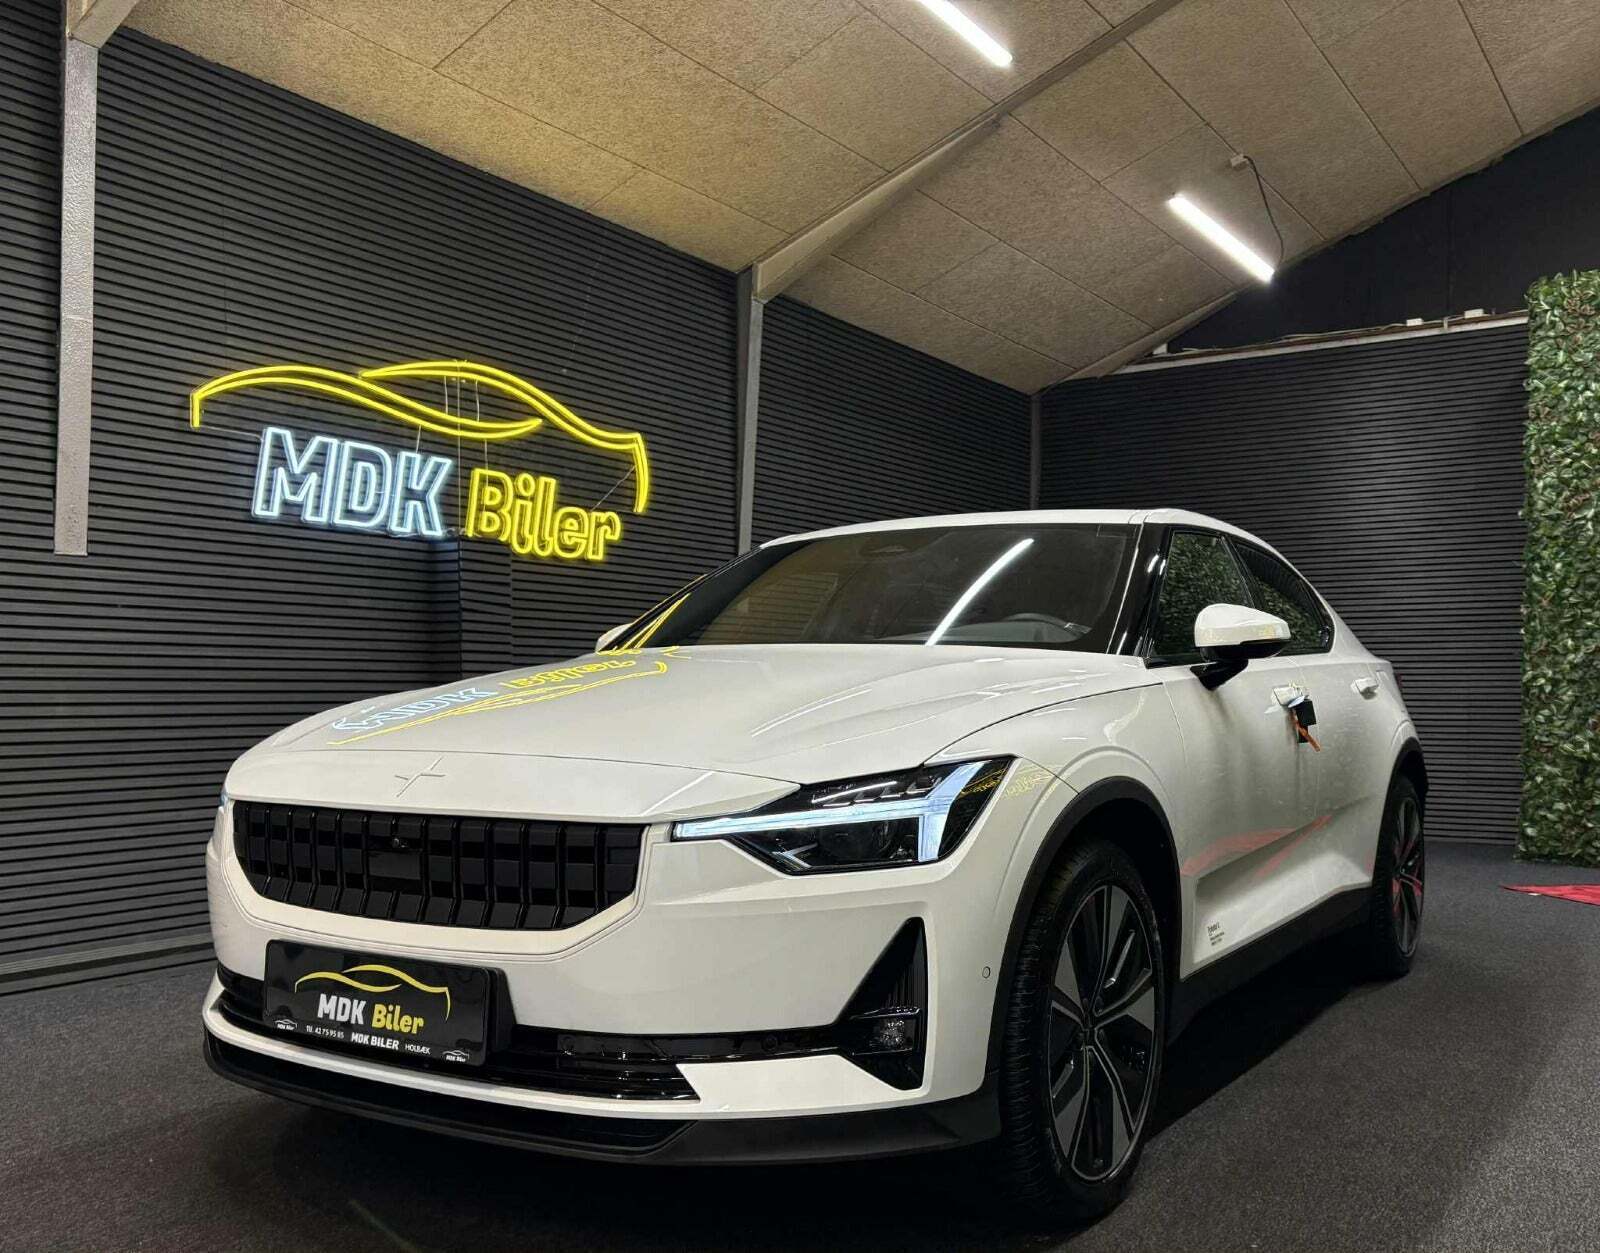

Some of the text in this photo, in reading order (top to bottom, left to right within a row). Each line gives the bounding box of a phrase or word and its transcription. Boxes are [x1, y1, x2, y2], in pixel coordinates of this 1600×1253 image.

[252, 427, 621, 561] MDK Biler
[317, 993, 424, 1034] MDK Biler
[351, 1032, 369, 1045] MDK
[370, 1036, 400, 1050] BILER
